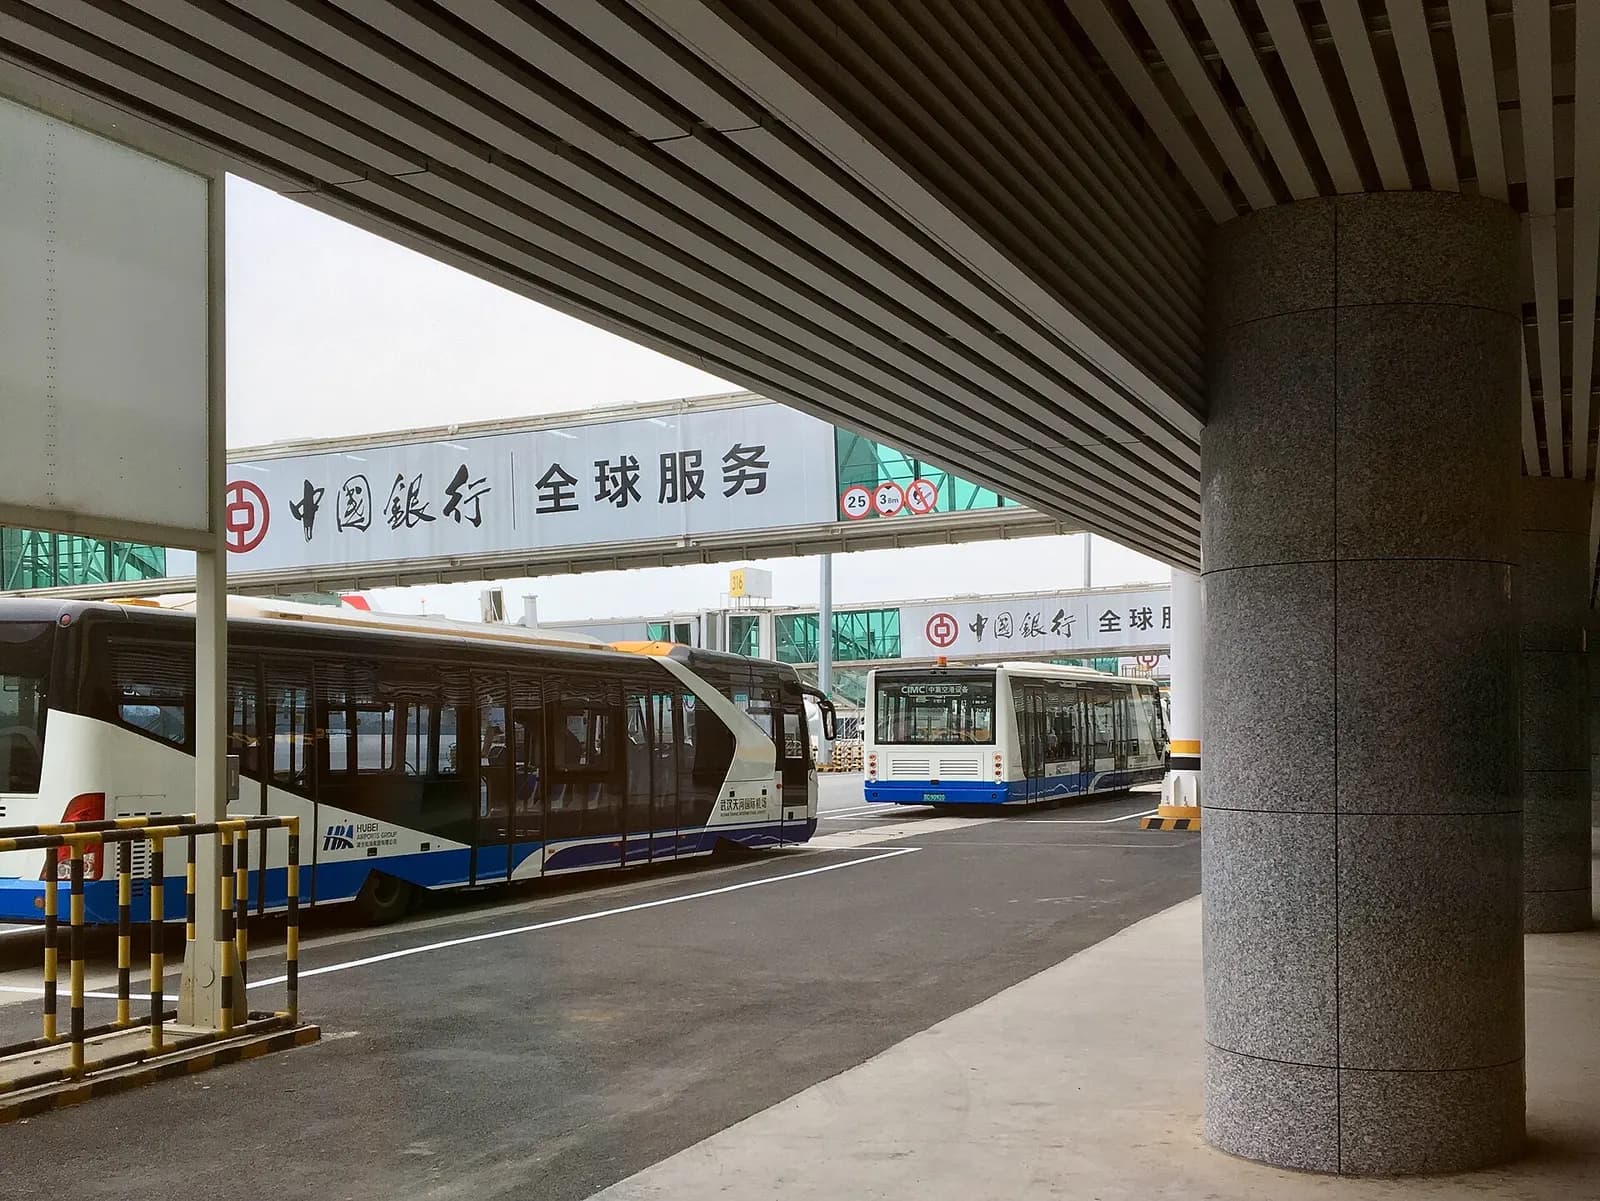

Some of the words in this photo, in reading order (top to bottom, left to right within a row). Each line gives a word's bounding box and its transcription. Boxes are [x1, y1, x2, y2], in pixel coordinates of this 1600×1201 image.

[535, 443, 770, 514] 全球服务
[848, 496, 866, 508] 25
[732, 575, 743, 590] 316
[901, 686, 926, 694] CIMC
[720, 797, 767, 811] 武汉天河国际机场
[356, 823, 379, 832] HUBEI
